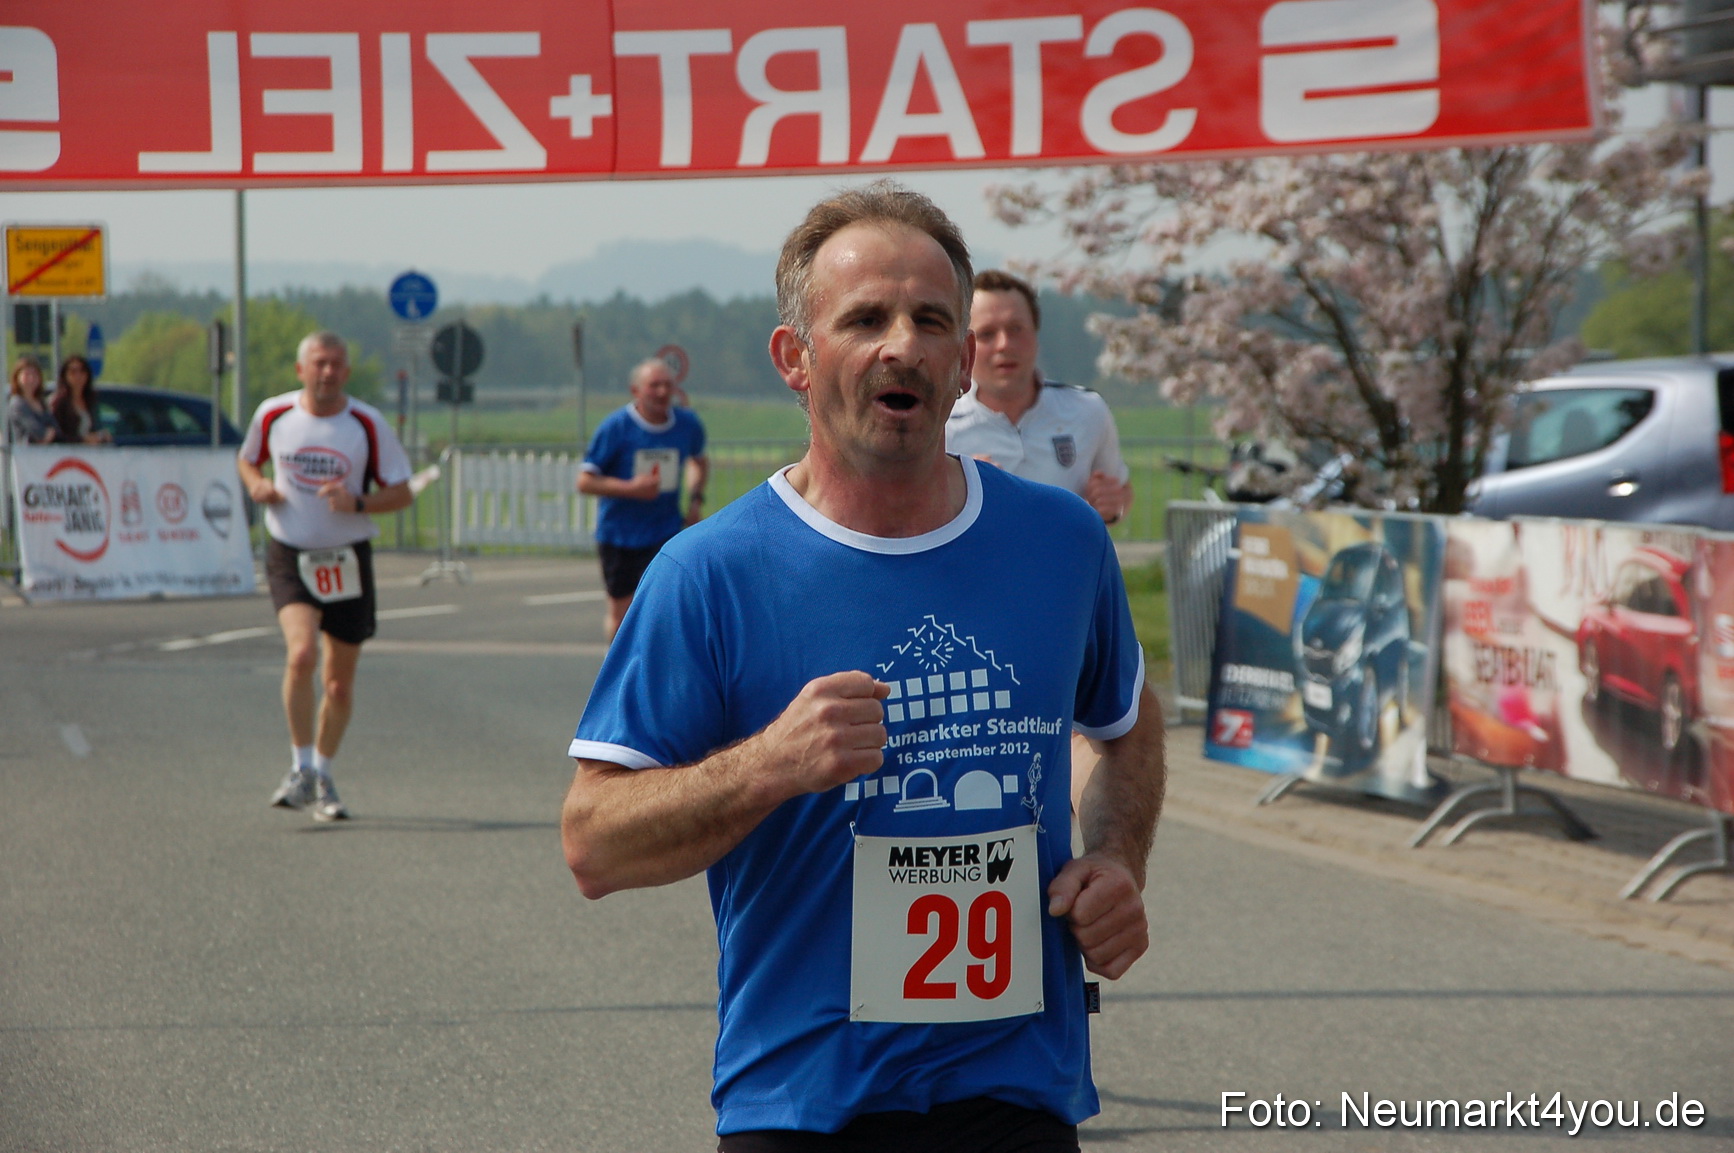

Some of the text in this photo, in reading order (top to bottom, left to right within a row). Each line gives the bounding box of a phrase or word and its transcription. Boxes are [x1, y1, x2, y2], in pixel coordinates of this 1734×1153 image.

[315, 565, 343, 595] 81
[881, 716, 1062, 750] umarkter Stadtlauf
[897, 742, 1030, 765] 16.September 2012
[888, 843, 980, 868] MEYER
[888, 866, 981, 884] WERBUNG
[903, 890, 1012, 1000] 29
